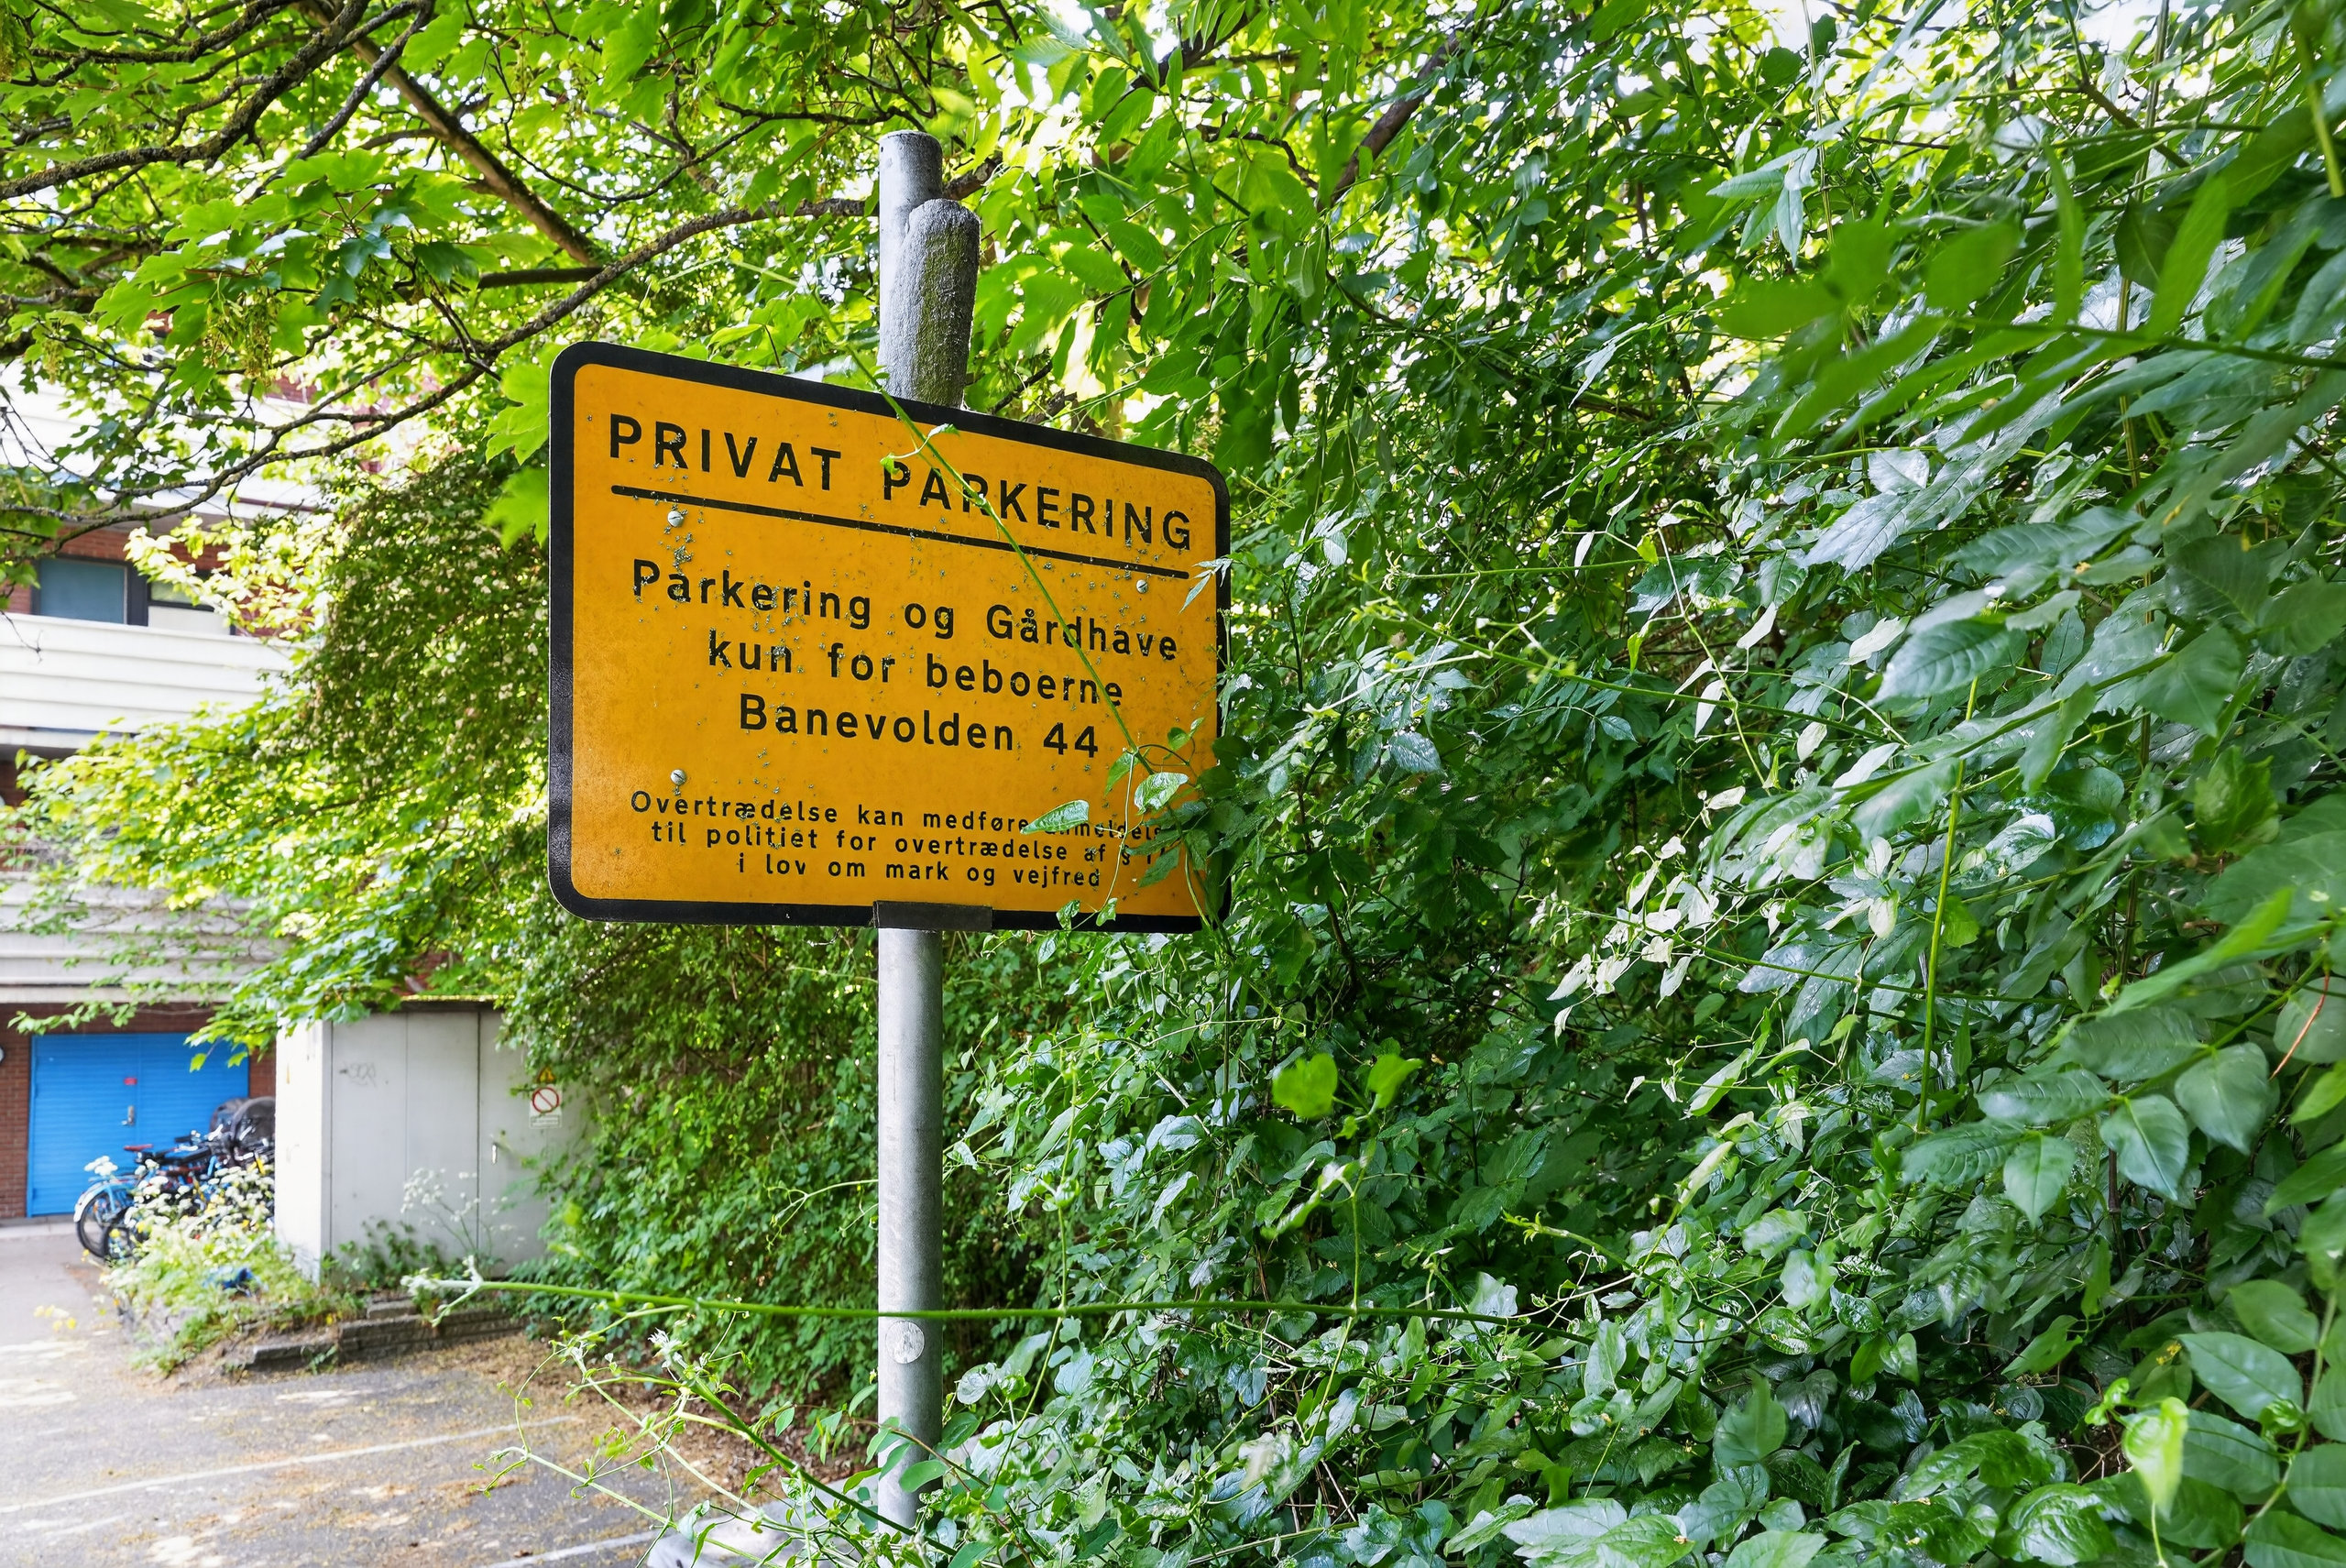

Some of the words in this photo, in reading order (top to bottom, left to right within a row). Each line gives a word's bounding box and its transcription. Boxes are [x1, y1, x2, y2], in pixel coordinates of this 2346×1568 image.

[609, 413, 841, 491] PRIVAT
[882, 458, 1191, 551] PARKERING
[632, 558, 872, 630] Parkering
[904, 603, 954, 640] og
[985, 604, 1178, 661] Gårdhave
[708, 629, 792, 674] kun
[827, 642, 895, 683] for
[926, 652, 1123, 707] beboerne
[740, 692, 1014, 751] Banevolden
[1043, 722, 1099, 758] 44
[630, 790, 838, 823] Overtrædelse
[858, 804, 904, 827] kan
[923, 810, 1029, 832] medføre
[651, 821, 686, 843] til
[707, 825, 817, 849] politiet
[836, 829, 876, 851] for
[894, 836, 1068, 861] overtrædelse
[1083, 843, 1106, 862] af
[739, 852, 744, 873] i
[766, 853, 806, 875] lov
[828, 861, 865, 877] om
[885, 861, 948, 881] mark
[967, 867, 995, 887] og
[1013, 865, 1100, 889] vejfred
